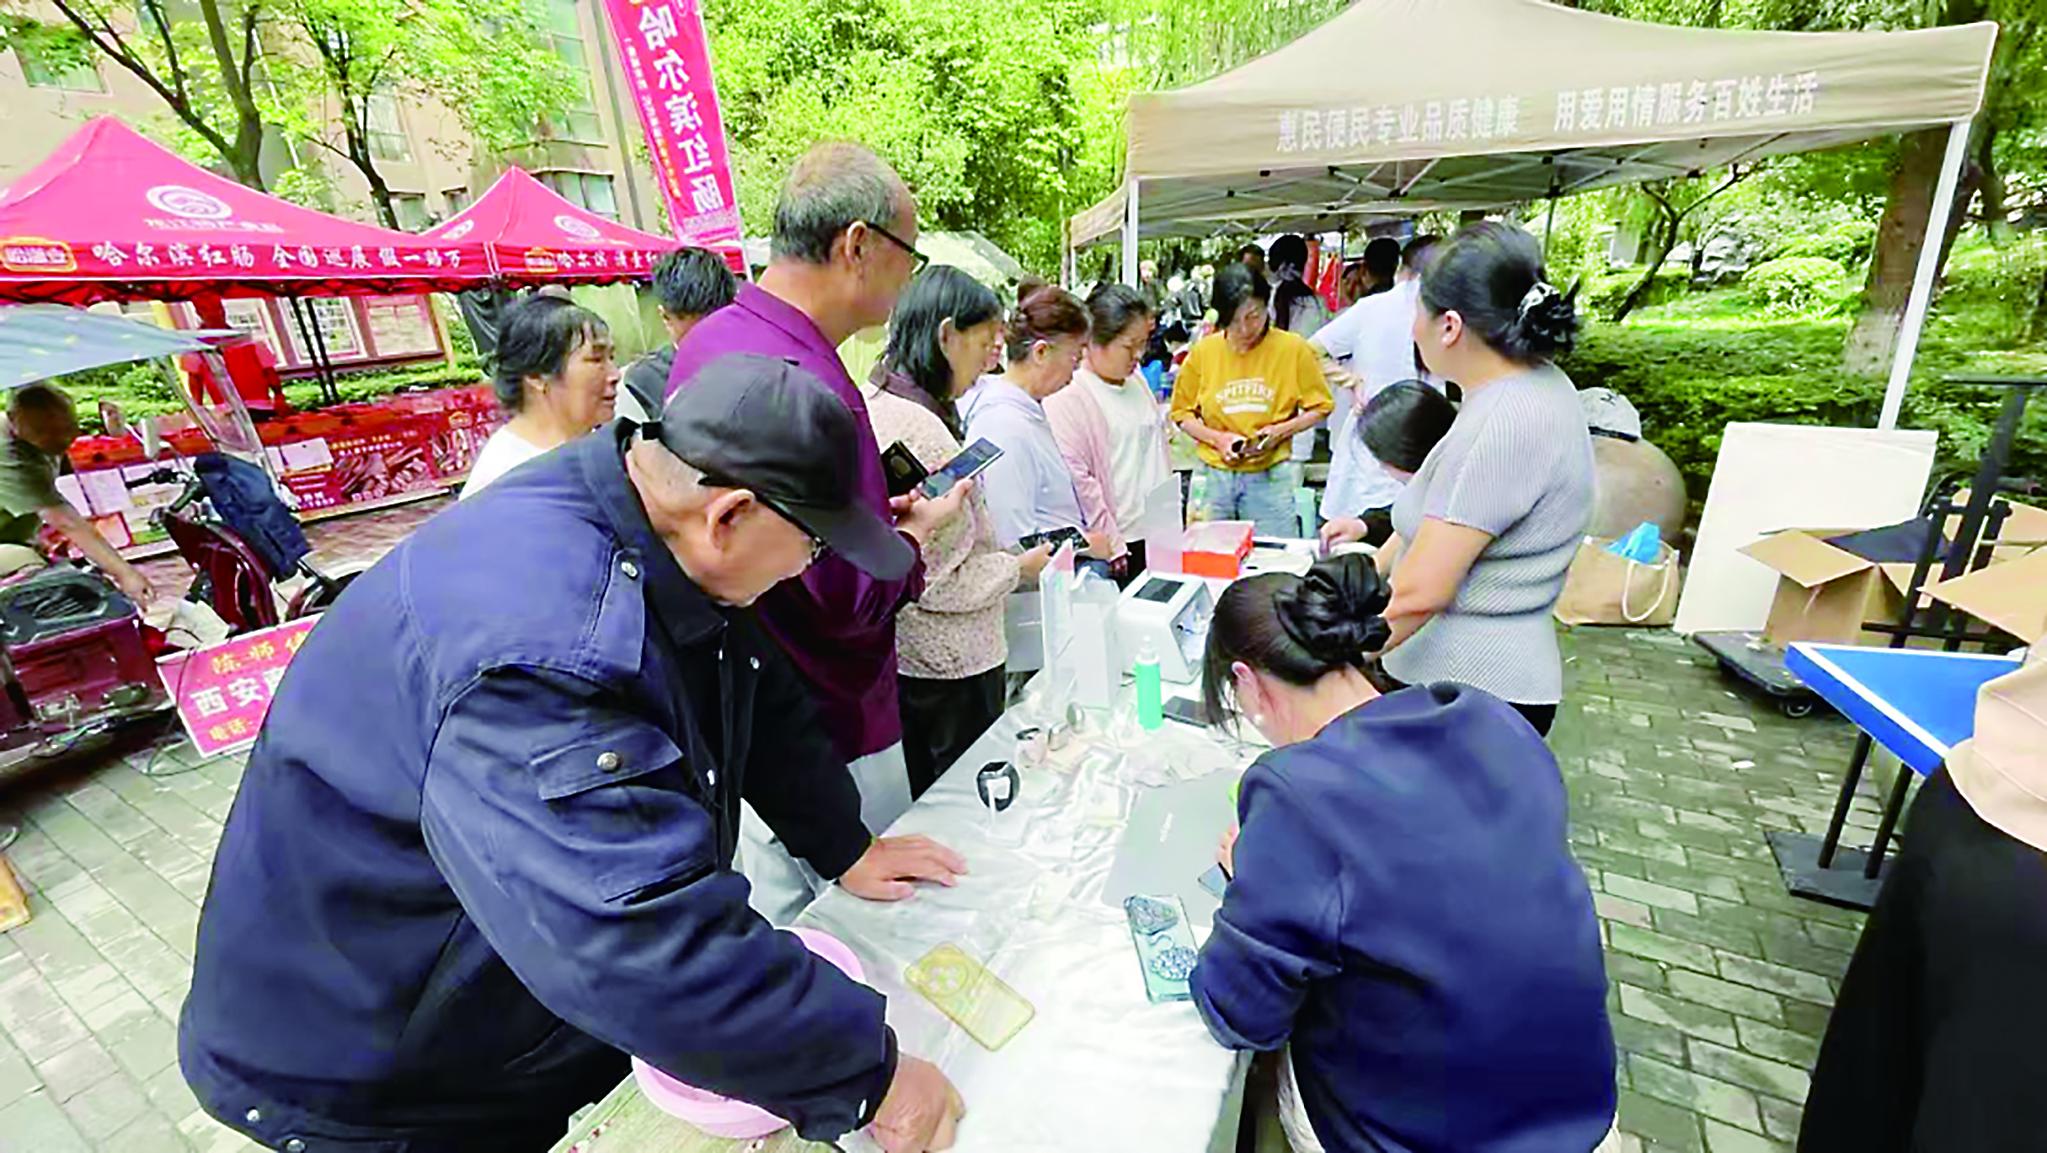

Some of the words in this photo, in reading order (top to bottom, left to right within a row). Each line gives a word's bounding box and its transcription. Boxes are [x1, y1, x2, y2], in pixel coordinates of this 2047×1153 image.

[1276, 94, 1521, 151] 惠民便民专业品质健康
[1554, 70, 1819, 132] 用爱用情服务百姓生活
[91, 240, 255, 267] 哈尔滨红肠
[1215, 382, 1275, 403] SPITFIRE
